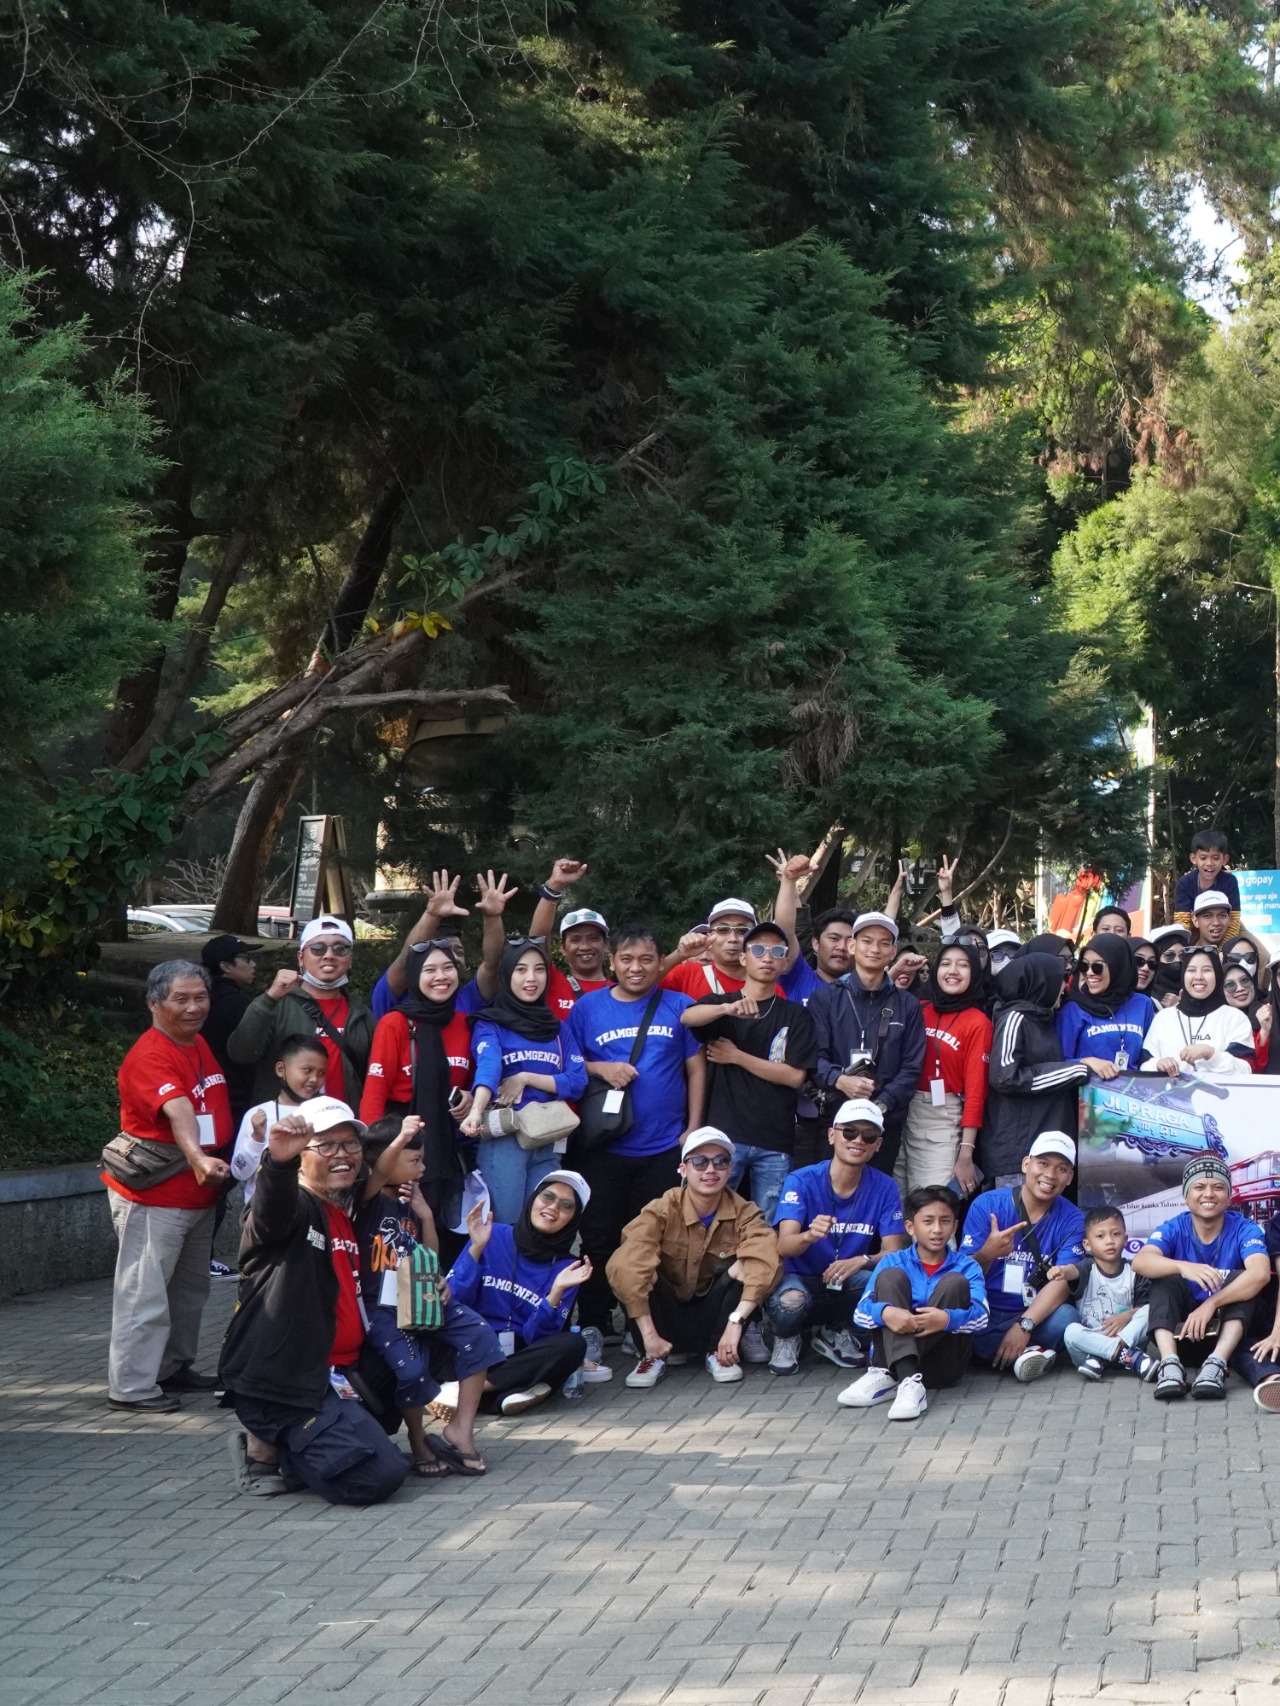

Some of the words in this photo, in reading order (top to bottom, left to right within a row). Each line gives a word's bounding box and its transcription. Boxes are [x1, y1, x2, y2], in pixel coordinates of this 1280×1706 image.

[1245, 876, 1274, 887] gopay
[595, 1026, 674, 1046] TEAMGEERAL
[1127, 1099, 1190, 1128] BRAGA
